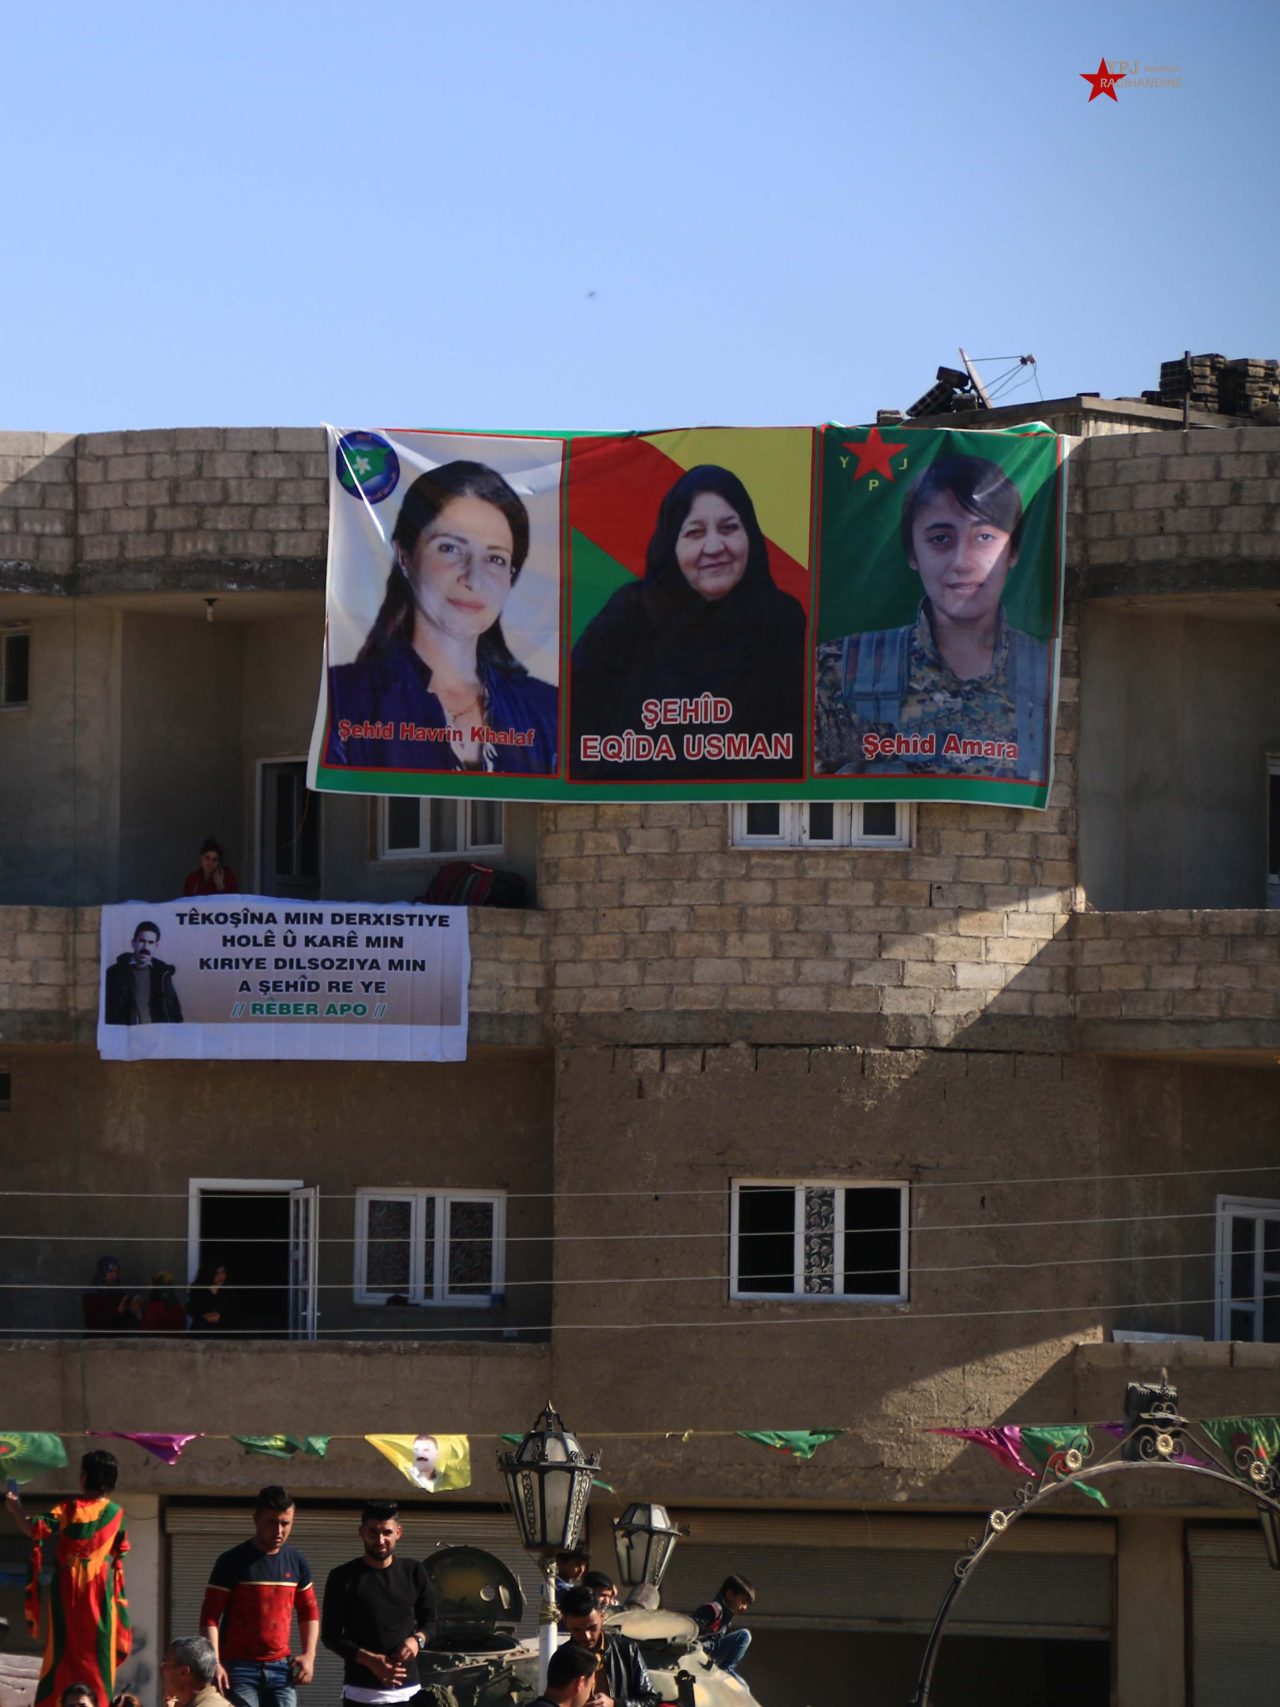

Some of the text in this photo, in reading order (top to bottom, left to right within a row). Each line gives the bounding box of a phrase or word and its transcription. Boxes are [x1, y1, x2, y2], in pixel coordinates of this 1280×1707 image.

[641, 691, 733, 730] ŞEHÎD
[338, 719, 394, 741] Şehîd
[470, 726, 535, 747] Khalaf
[580, 729, 793, 762] EQÎDA USMAN
[862, 732, 1018, 760] Şehîd Amara
[175, 907, 451, 929] TÊKOŞÎNA MIN DERXISTIYE
[221, 929, 404, 949] HOLÊ Û KARÊ MIN
[199, 957, 426, 972] KIRIYE DILSOZIYA MIN
[238, 974, 386, 996] A ŞEHÎD RE YE
[324, 1002, 368, 1017] APO
